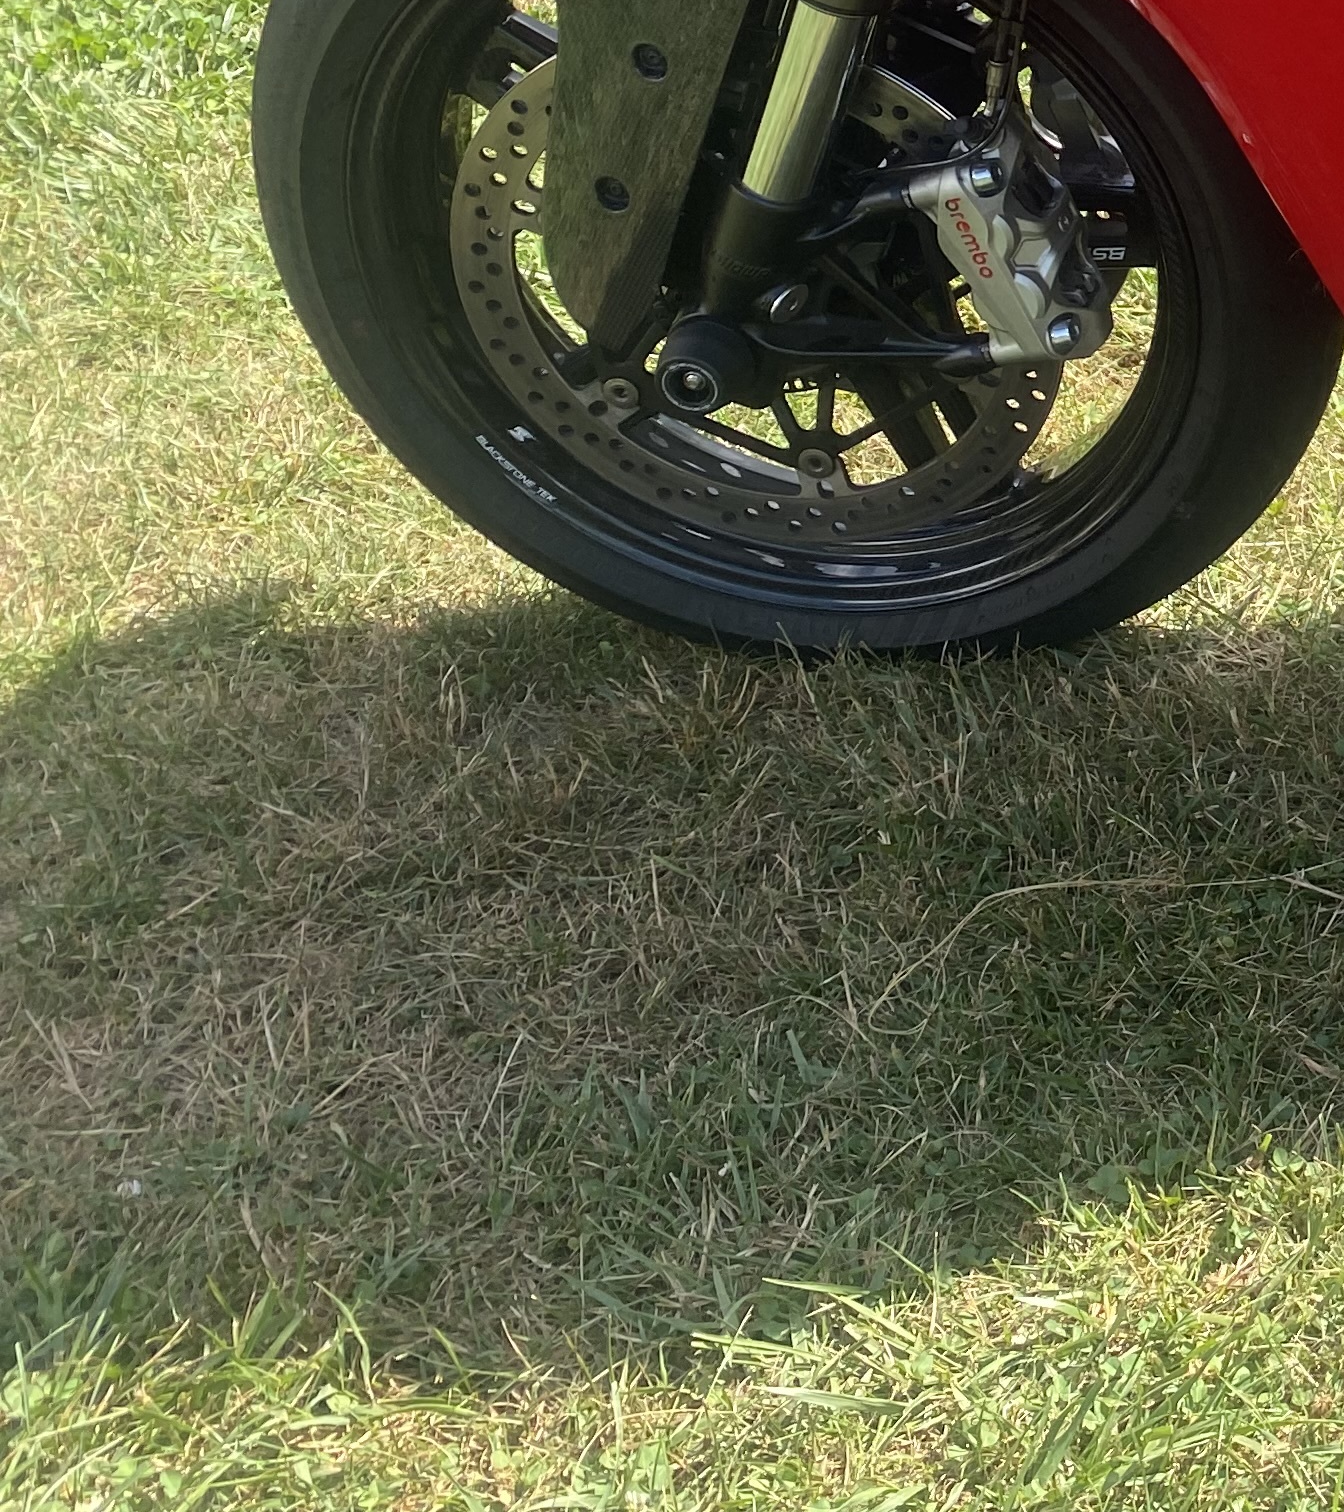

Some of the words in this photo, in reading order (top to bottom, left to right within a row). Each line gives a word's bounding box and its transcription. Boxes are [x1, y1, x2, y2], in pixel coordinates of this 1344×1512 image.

[945, 198, 993, 279] brembo
[1090, 246, 1126, 261] BS
[475, 434, 536, 487] BLACKSTONE
[537, 486, 558, 503] TEK
